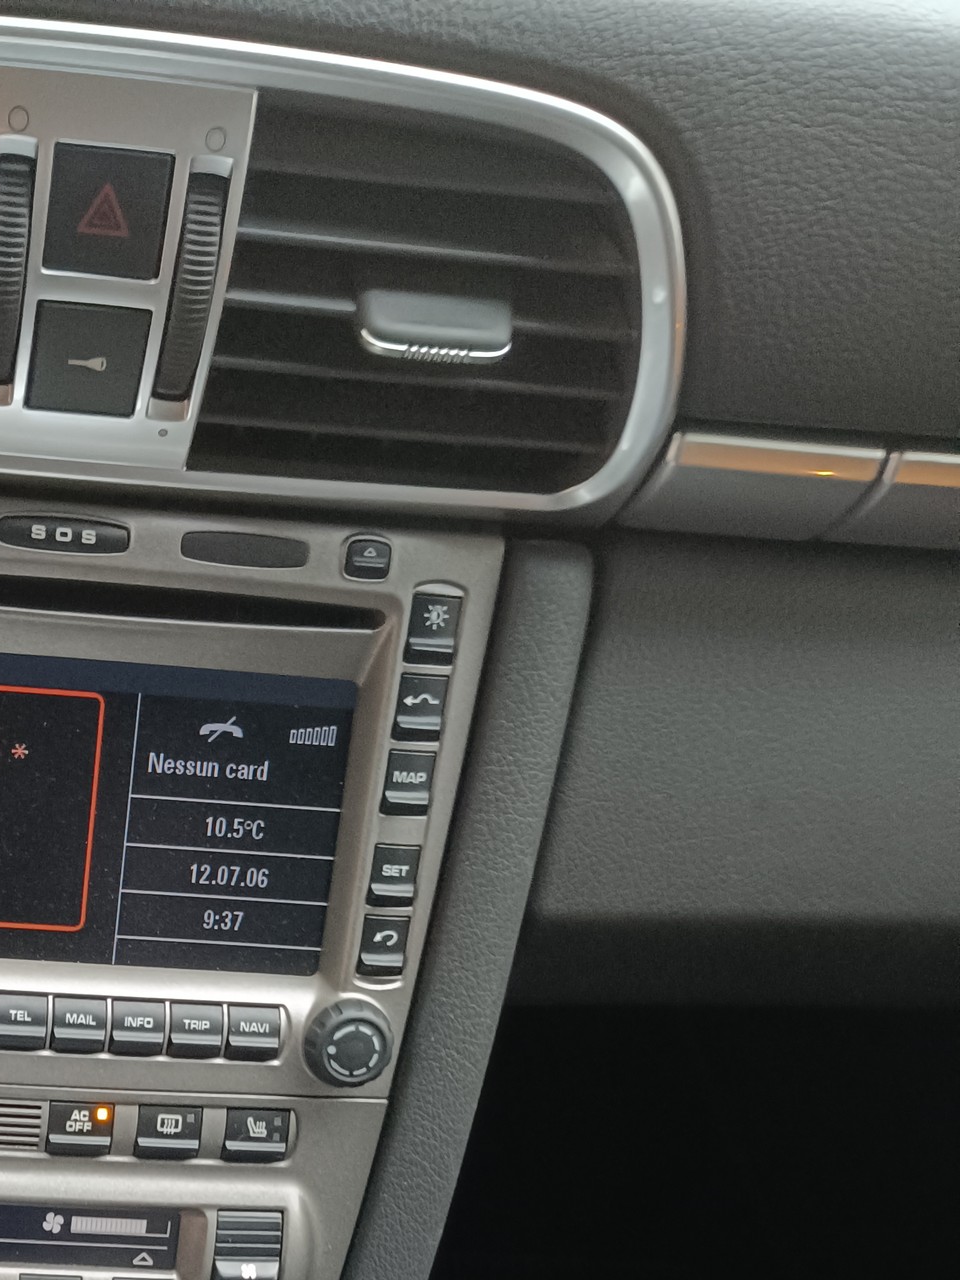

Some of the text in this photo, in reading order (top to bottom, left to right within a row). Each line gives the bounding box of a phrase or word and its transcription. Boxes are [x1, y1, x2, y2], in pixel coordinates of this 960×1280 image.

[147, 751, 270, 782] Nessun card
[392, 770, 428, 785] MAP
[190, 863, 270, 889] 12.07.06
[381, 864, 411, 878] SET
[202, 909, 245, 932] 9:37
[9, 1009, 32, 1022] TEL
[65, 1012, 96, 1026] MAIL
[124, 1016, 154, 1029] INFO
[183, 1019, 210, 1031] TRIP
[239, 1021, 270, 1034] NAVI
[70, 1109, 89, 1122] AC
[65, 1121, 92, 1133] OFF
